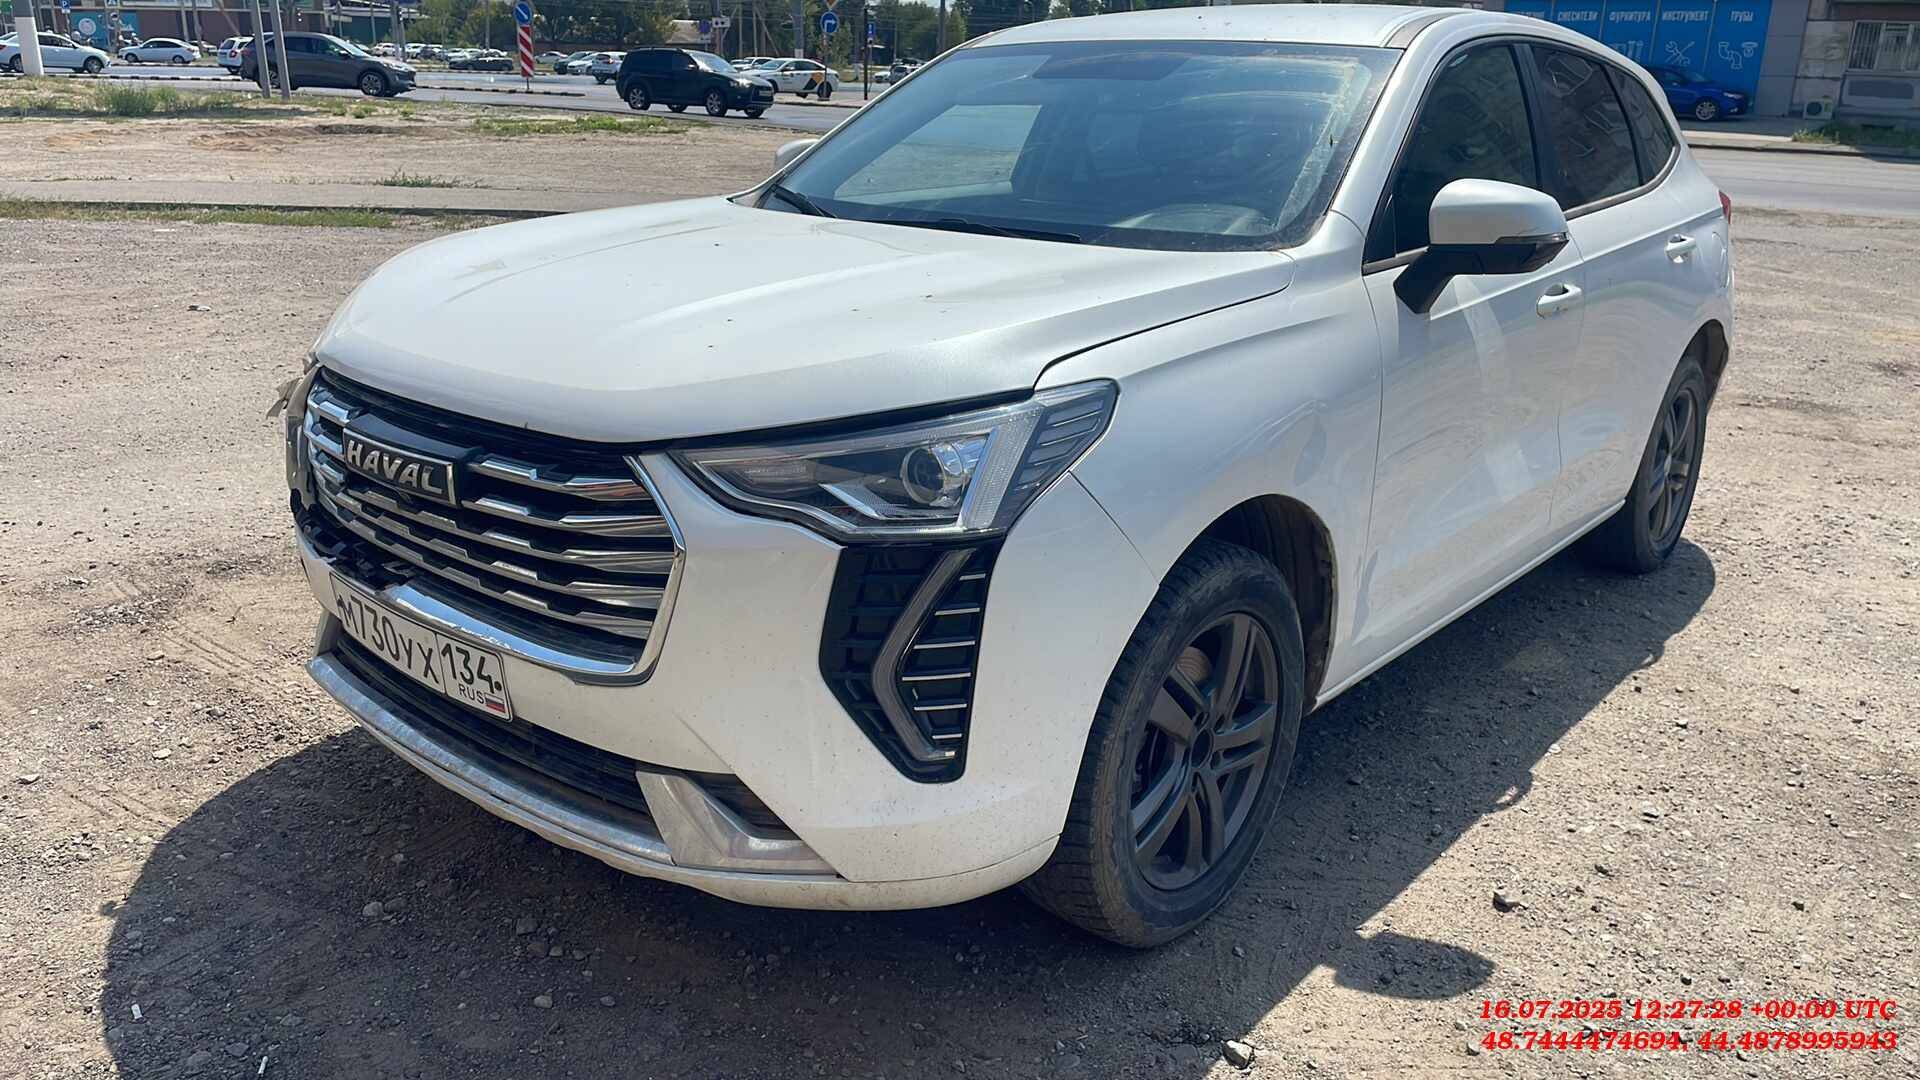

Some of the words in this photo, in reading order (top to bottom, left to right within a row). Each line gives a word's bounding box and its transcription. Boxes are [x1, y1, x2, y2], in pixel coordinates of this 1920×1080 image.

[346, 439, 443, 495] HAVAL
[441, 642, 495, 695] 134
[458, 683, 486, 704] RUS
